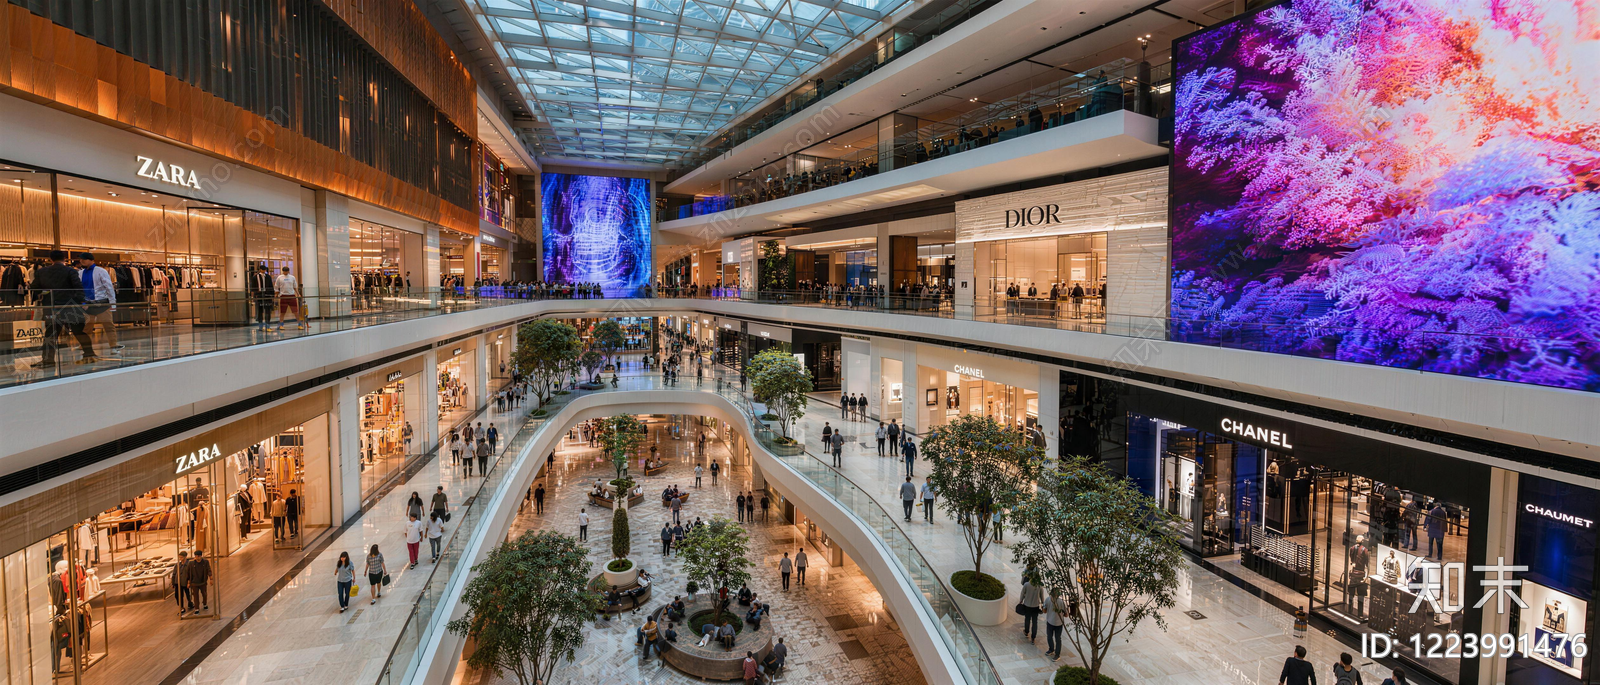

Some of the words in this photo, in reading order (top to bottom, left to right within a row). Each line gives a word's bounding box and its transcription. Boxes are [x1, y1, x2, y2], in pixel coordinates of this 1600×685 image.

[137, 155, 201, 190] ZARA
[1004, 203, 1062, 229] DIOR
[954, 364, 985, 379] CHANEL
[1221, 417, 1294, 450] CHANEL
[175, 443, 222, 474] ZARA
[1525, 503, 1594, 529] CHAUMET
